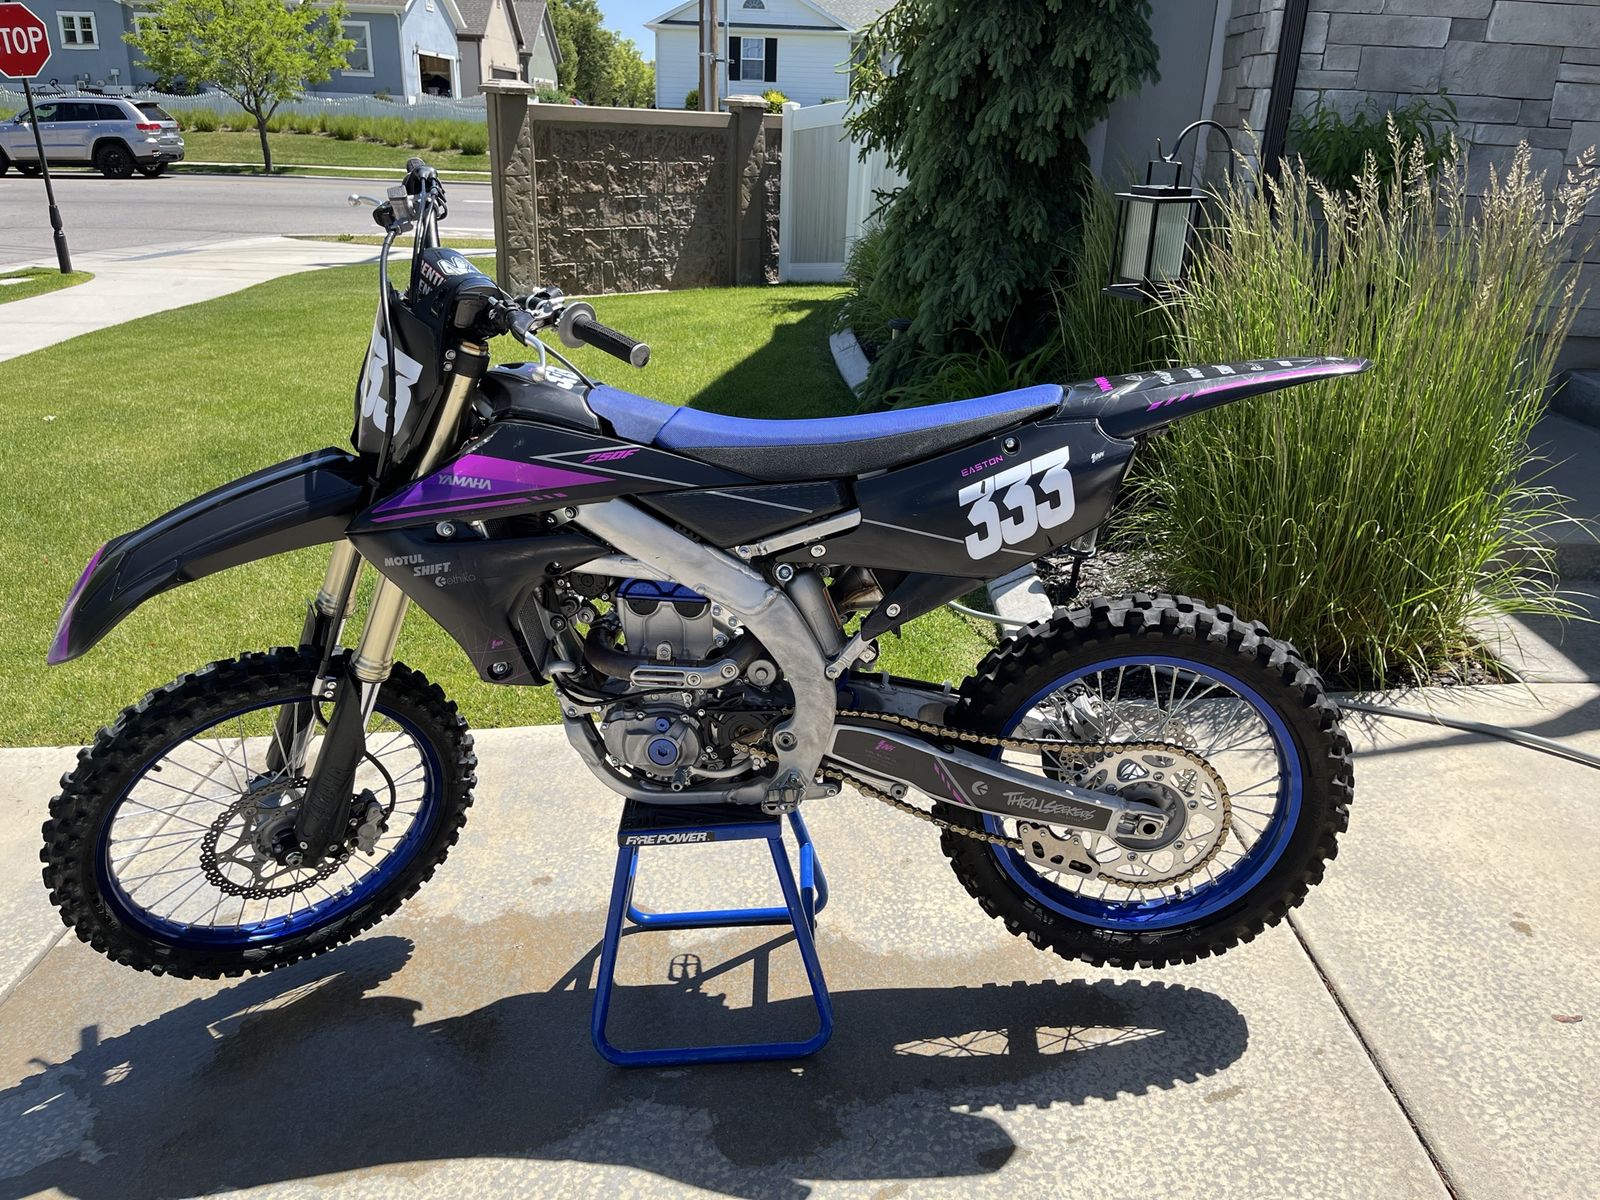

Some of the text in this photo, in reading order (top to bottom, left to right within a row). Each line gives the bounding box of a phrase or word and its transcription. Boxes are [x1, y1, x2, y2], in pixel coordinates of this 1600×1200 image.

[0, 26, 43, 55] TOP
[582, 448, 641, 464] 250F
[960, 455, 1004, 477] EASTON
[438, 474, 492, 491] YAMAHA
[958, 445, 1076, 561] 333
[384, 553, 425, 567] MOTUL
[413, 562, 451, 577] SHIFT
